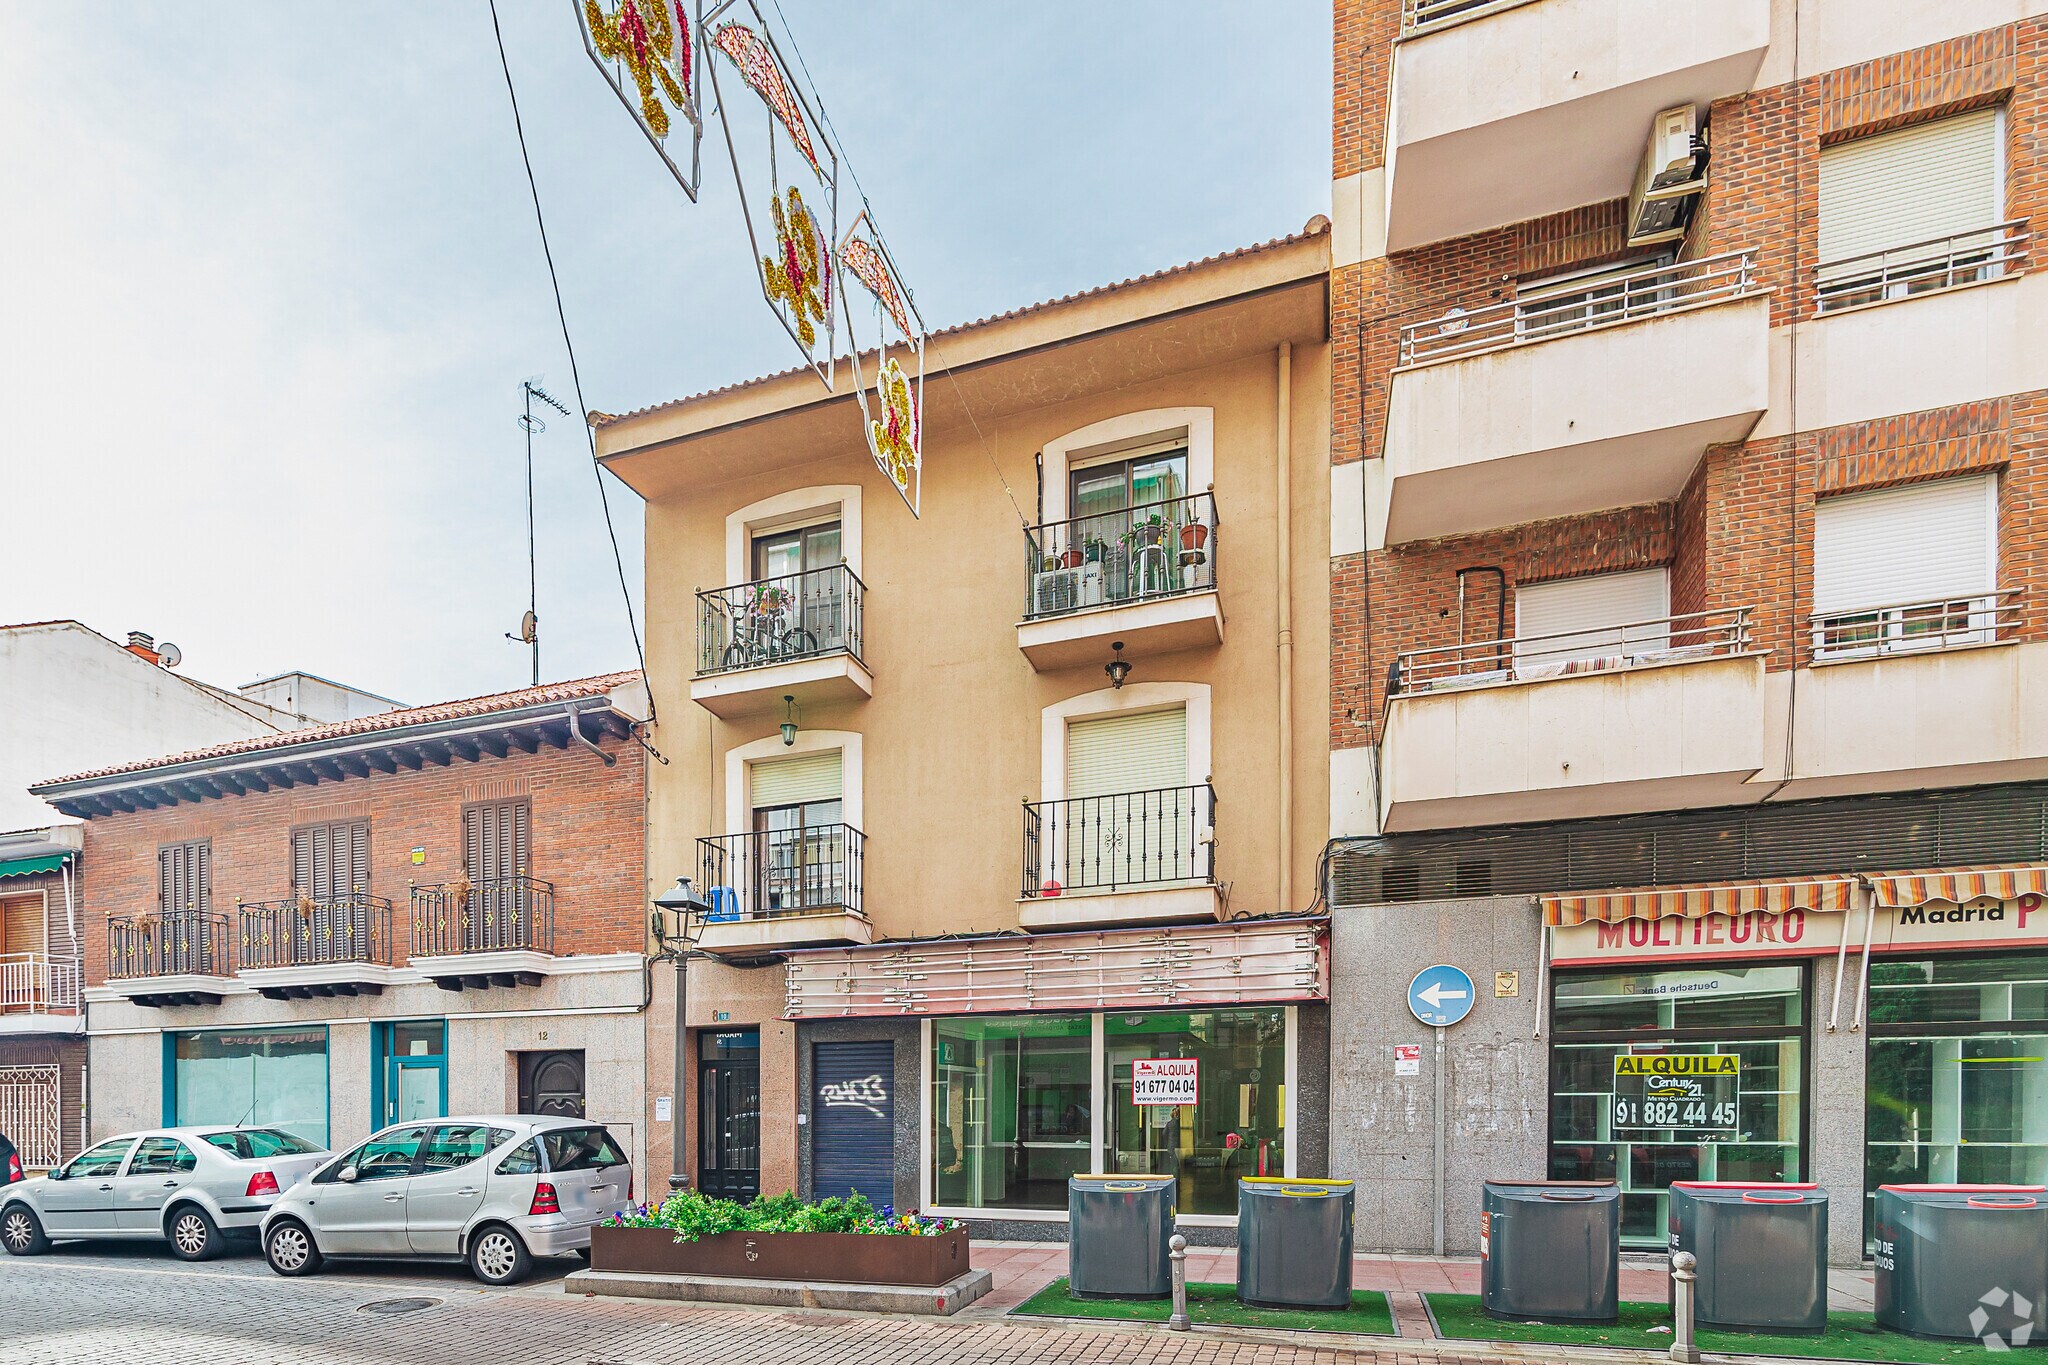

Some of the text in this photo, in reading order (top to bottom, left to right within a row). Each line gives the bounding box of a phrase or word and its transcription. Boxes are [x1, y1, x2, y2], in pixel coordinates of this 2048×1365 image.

[1900, 901, 2004, 925] Madrid
[712, 1010, 718, 1022] 8
[539, 1031, 548, 1041] 12
[1157, 1065, 1195, 1076] ALQUILA
[1617, 1057, 1737, 1074] ALQUILA
[1135, 1080, 1195, 1093] 91 677 04 04
[1648, 1075, 1693, 1089] Century
[1616, 1101, 1736, 1125] 91 882 44 45
[1882, 1241, 1894, 1255] DE
